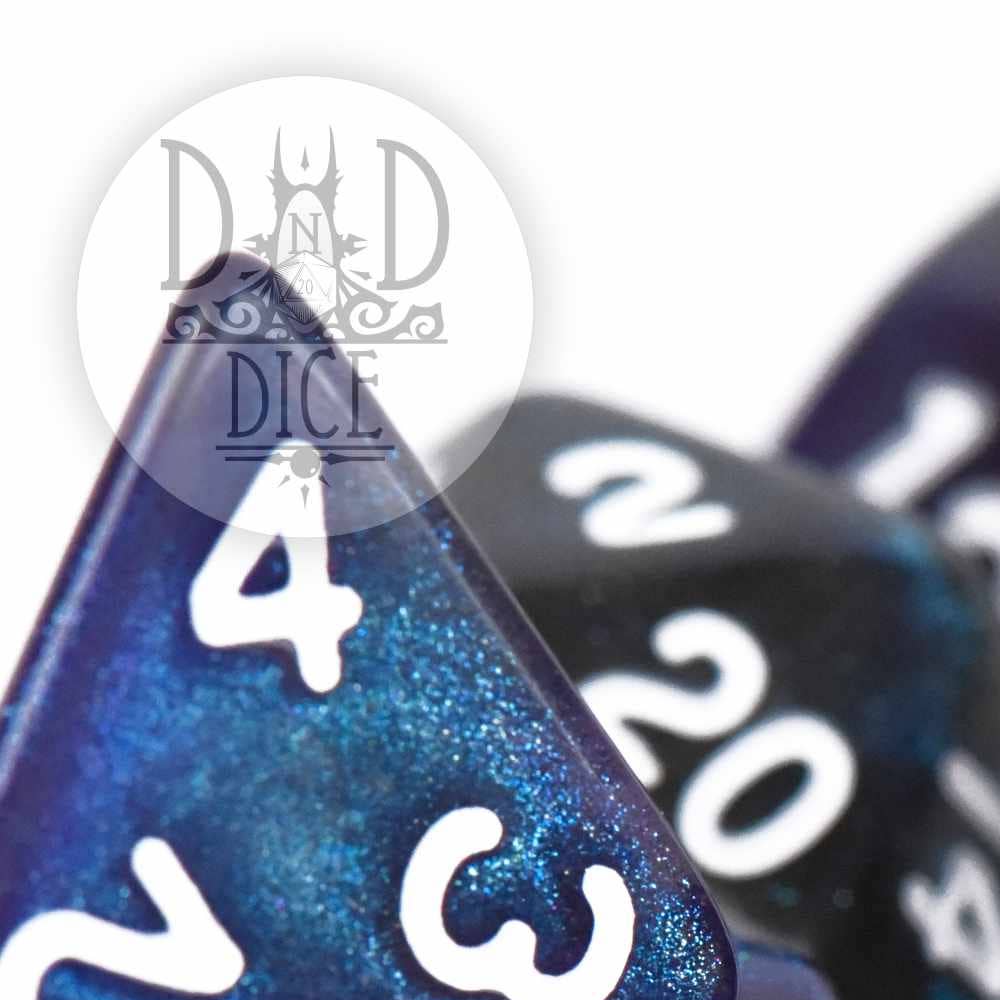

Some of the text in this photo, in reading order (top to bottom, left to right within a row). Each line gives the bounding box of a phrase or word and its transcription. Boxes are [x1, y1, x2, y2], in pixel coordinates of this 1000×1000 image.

[189, 439, 364, 693] 4
[544, 439, 735, 549] 2
[579, 612, 854, 877] 20
